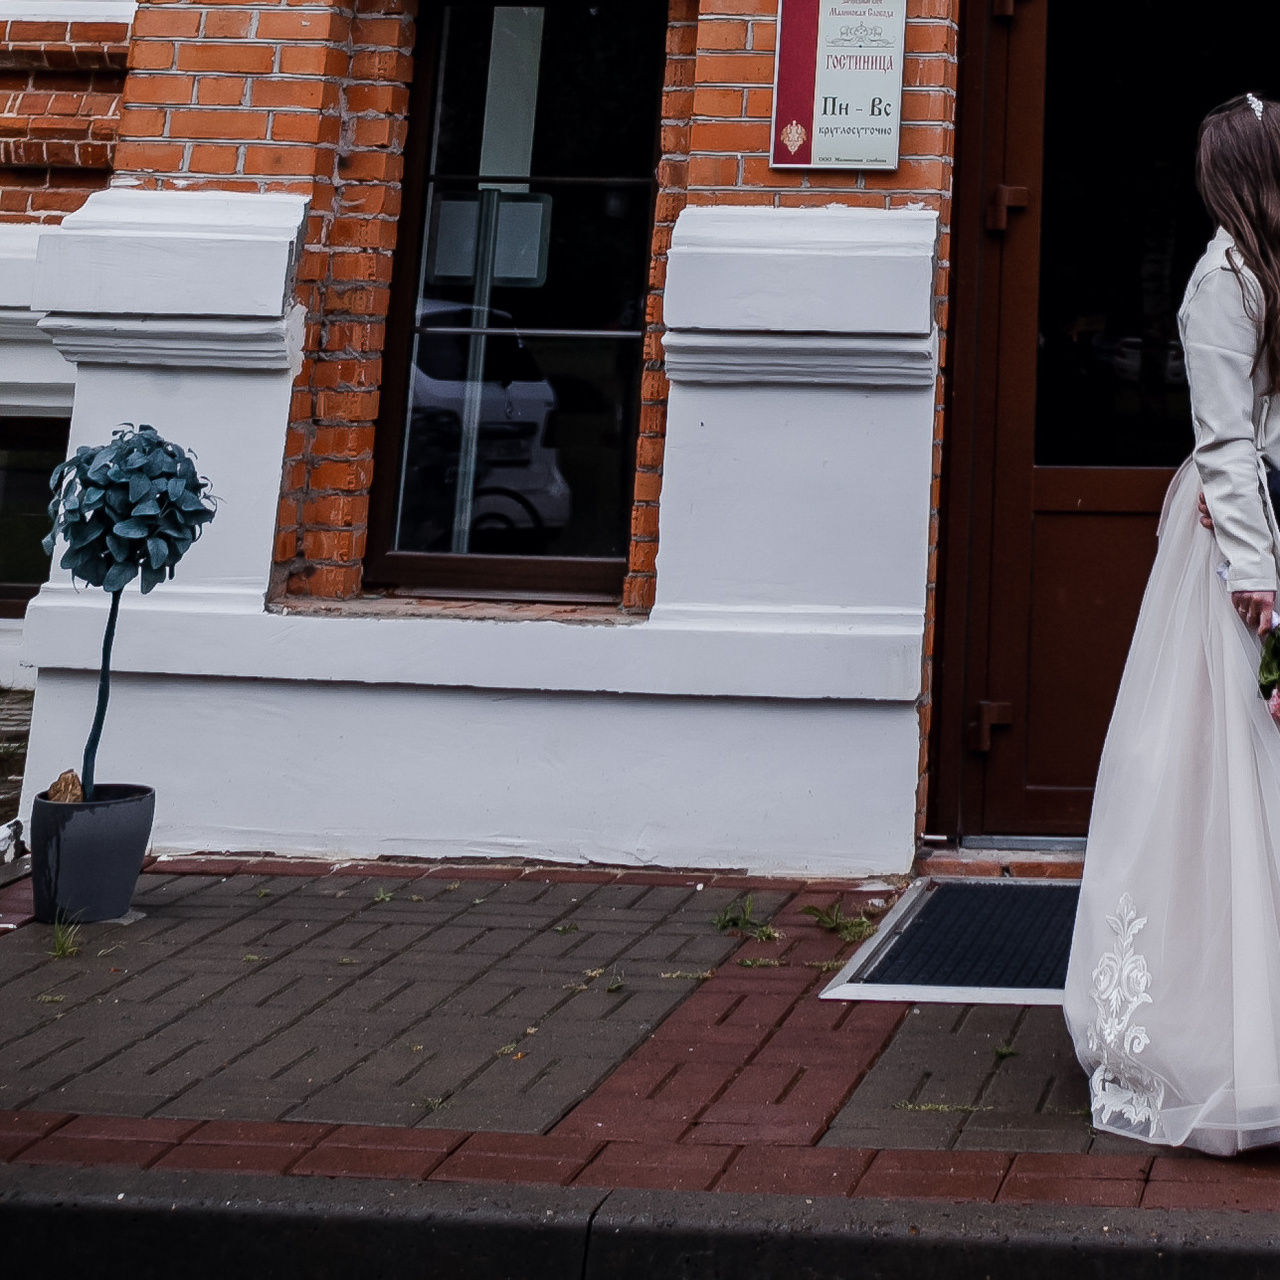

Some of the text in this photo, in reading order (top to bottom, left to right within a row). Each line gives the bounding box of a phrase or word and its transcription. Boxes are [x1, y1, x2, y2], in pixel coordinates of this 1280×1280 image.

[829, 7, 894, 18] Малиновая Слобода
[826, 54, 894, 75] ГОСТИНИЦА
[821, 96, 849, 116] Пн
[869, 96, 892, 117] Вс
[818, 126, 892, 139] круглосуточно
